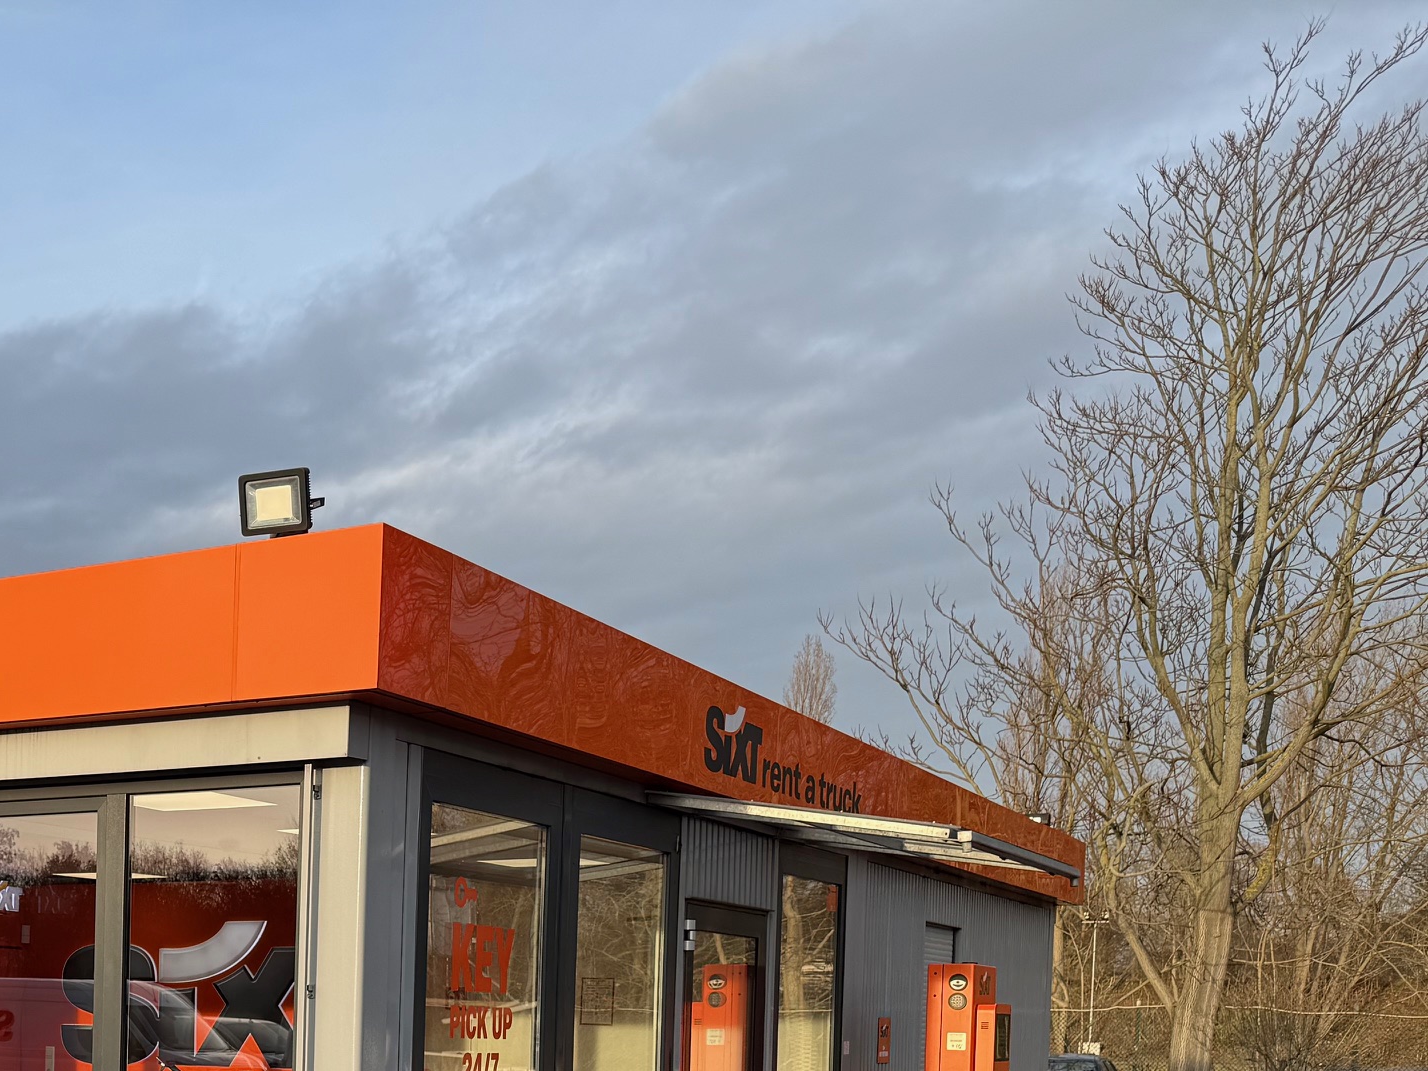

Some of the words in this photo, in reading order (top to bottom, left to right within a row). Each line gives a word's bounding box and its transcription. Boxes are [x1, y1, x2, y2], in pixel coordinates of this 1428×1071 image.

[704, 705, 763, 785] SIXT
[762, 758, 801, 800] rent
[805, 774, 816, 805] a
[819, 772, 862, 814] truck
[61, 921, 295, 1067] SIX
[451, 922, 515, 994] KEY
[449, 1005, 488, 1039] PICK
[492, 1007, 513, 1040] UP
